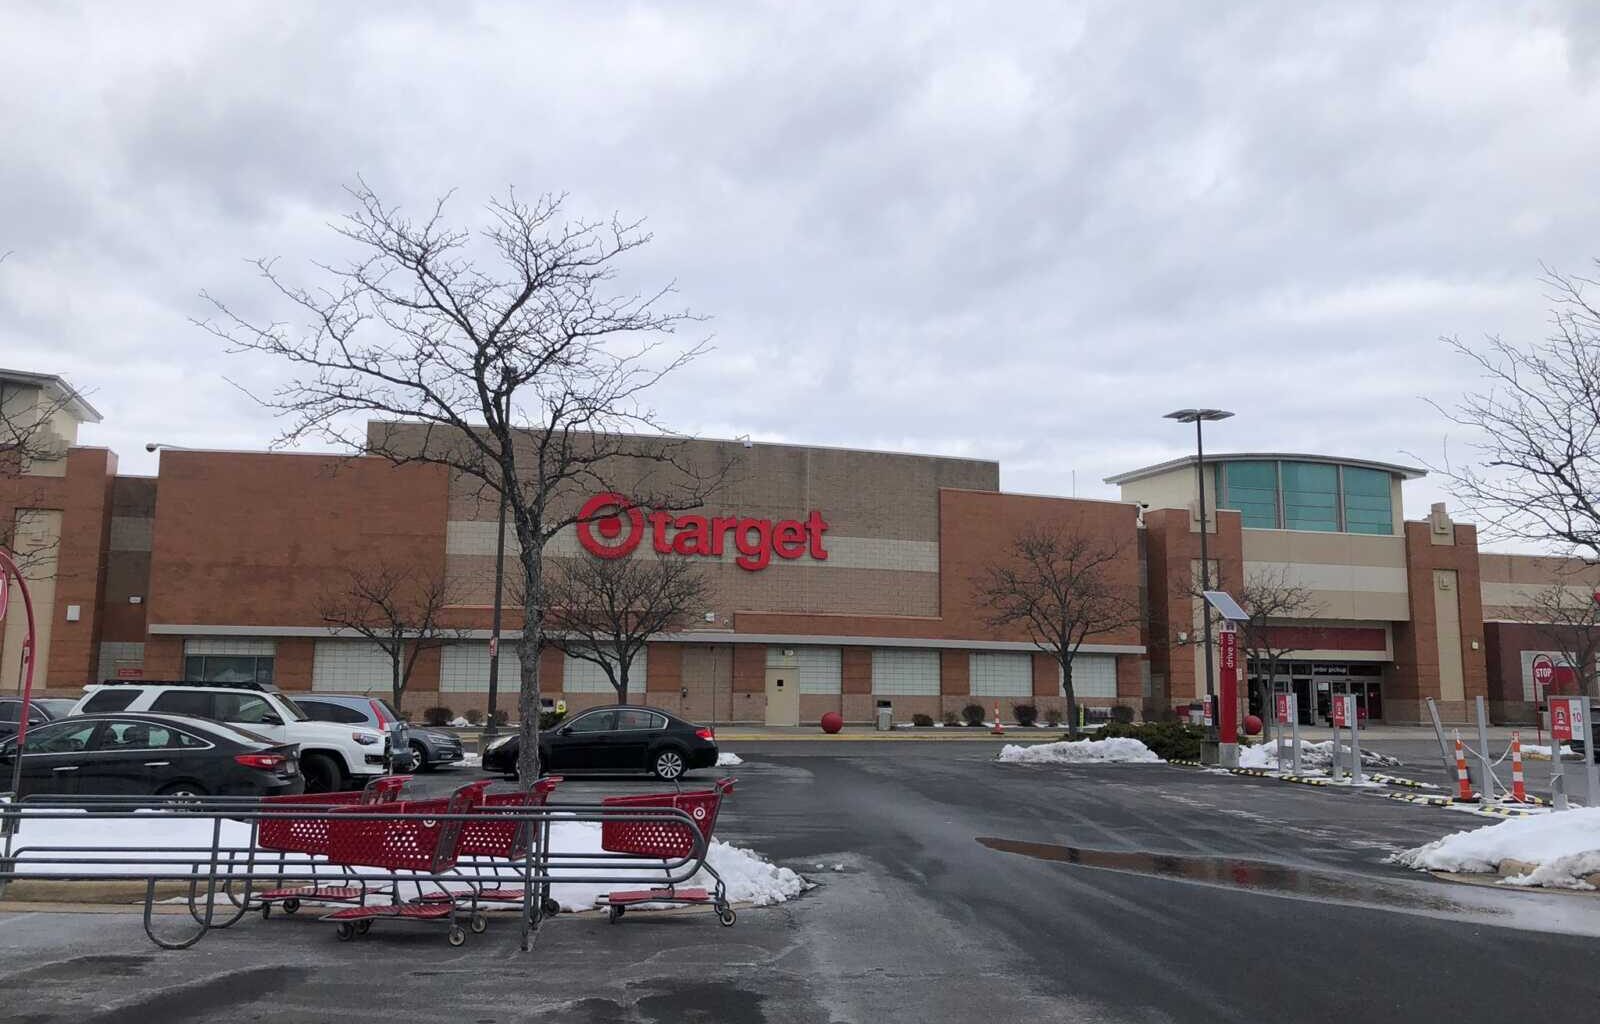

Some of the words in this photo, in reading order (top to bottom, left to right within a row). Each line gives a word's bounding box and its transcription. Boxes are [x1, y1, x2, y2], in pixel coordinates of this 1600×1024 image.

[648, 504, 828, 571] target
[1227, 633, 1234, 646] up
[1226, 647, 1234, 668] drive
[1535, 668, 1552, 677] STOP
